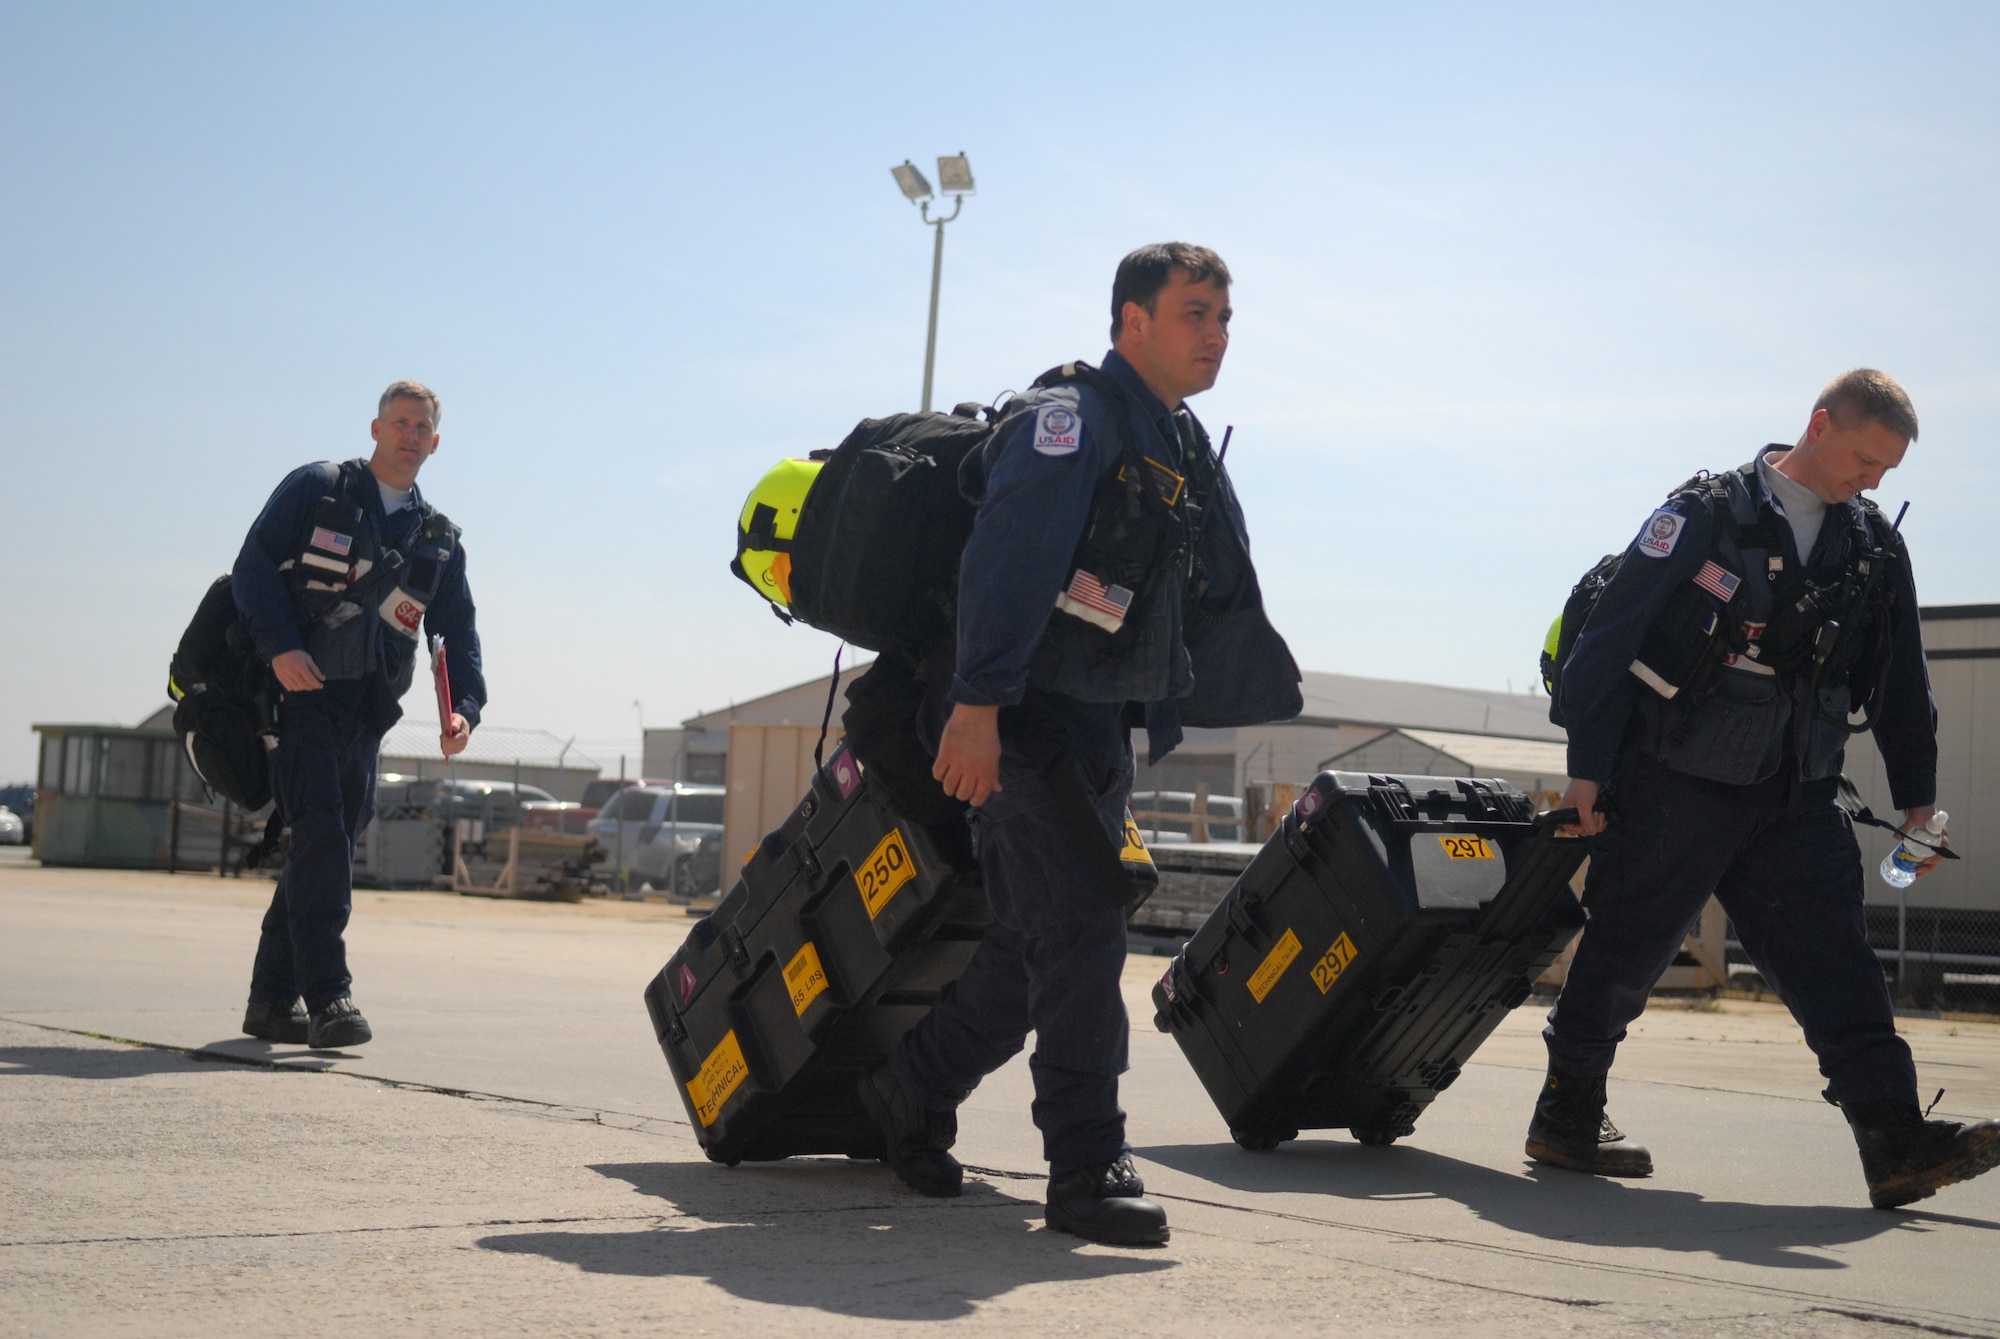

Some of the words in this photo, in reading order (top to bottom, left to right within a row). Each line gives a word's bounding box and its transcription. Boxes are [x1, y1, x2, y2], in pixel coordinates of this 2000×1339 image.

[1039, 435, 1075, 446] USAID
[1643, 536, 1670, 550] USAID
[1445, 839, 1485, 857] 297
[863, 843, 904, 901] 250
[1316, 938, 1349, 989] 297
[793, 988, 805, 1007] 65
[804, 970, 823, 991] LBS
